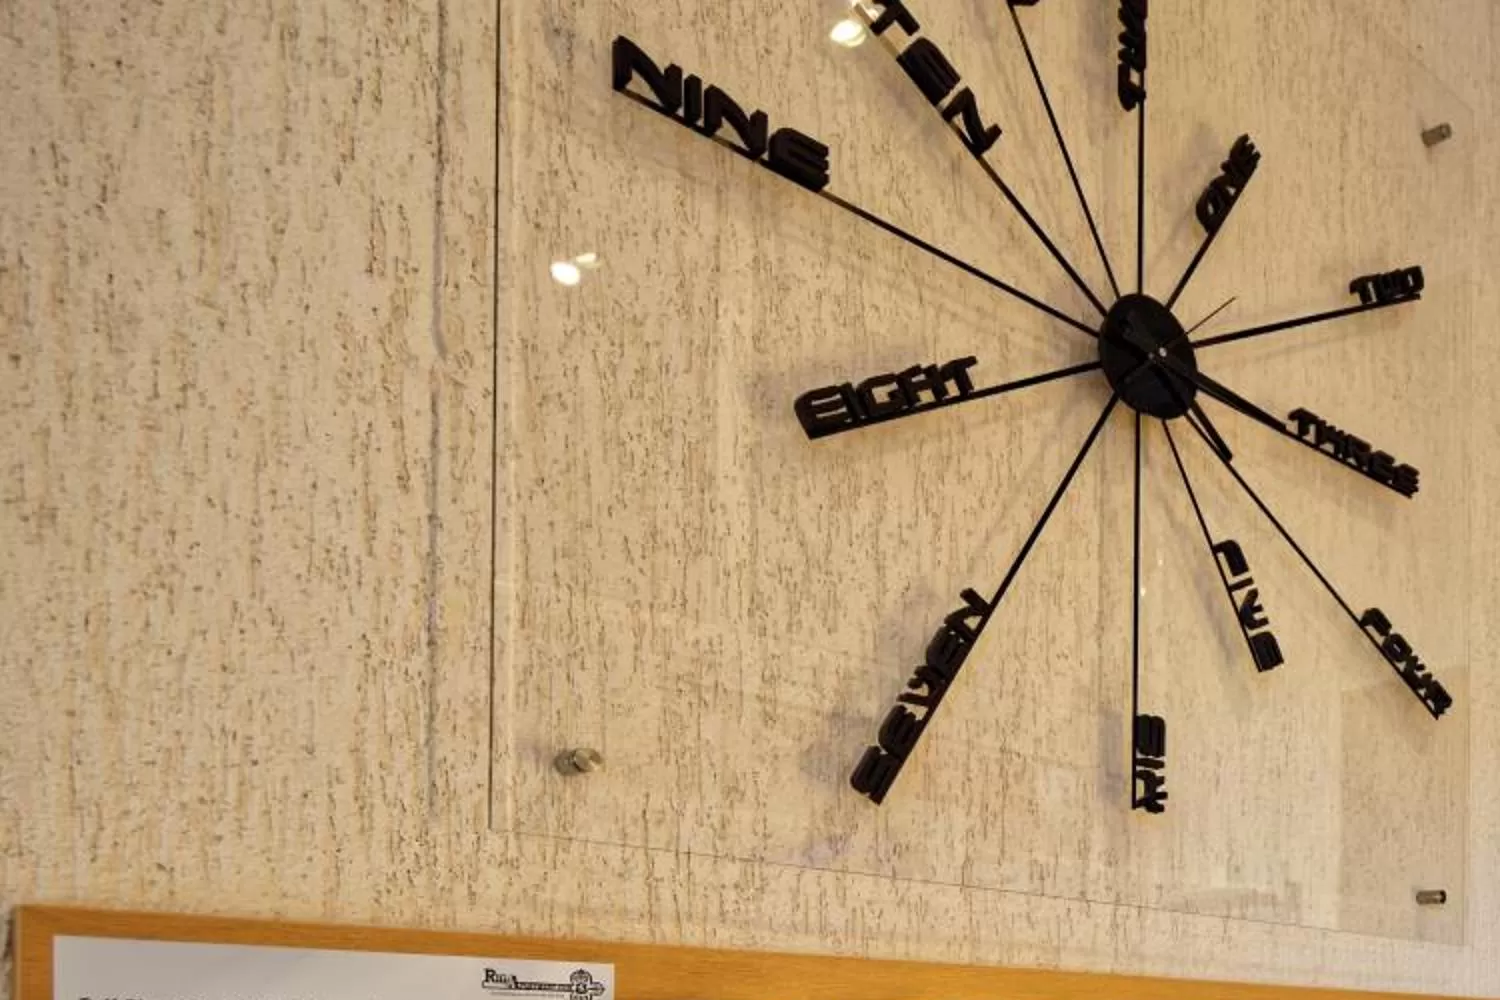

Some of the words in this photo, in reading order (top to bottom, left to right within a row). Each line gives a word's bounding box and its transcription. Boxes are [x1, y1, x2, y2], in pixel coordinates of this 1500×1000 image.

[611, 35, 830, 192] NINE
[1195, 133, 1261, 234] ONE
[1349, 265, 1424, 308] TWO
[793, 356, 979, 439] EIGHT
[1285, 408, 1420, 500] THREE
[1212, 539, 1284, 672] FIVE
[850, 587, 995, 804] SEVEN
[1359, 607, 1453, 720] FOUR
[1132, 713, 1168, 813] SIX
